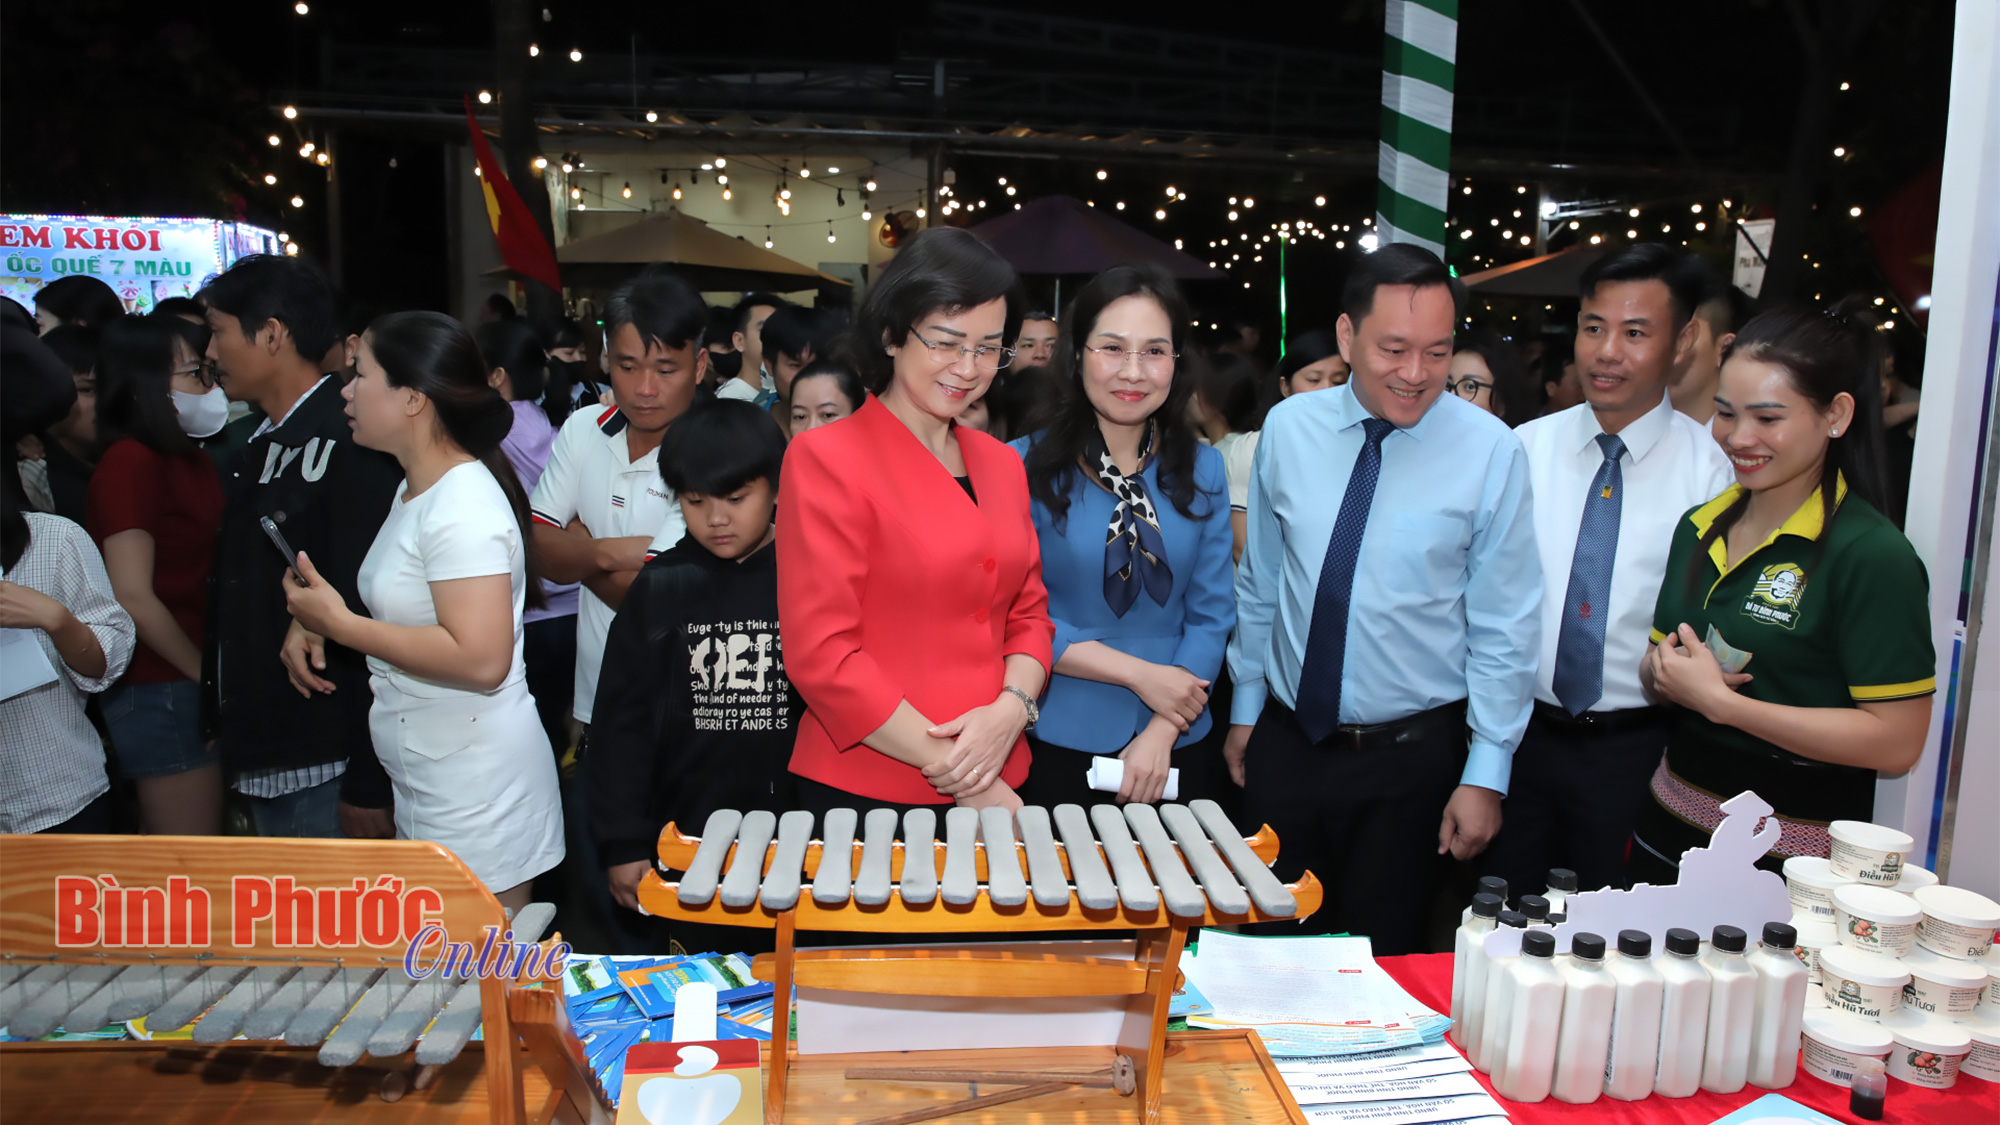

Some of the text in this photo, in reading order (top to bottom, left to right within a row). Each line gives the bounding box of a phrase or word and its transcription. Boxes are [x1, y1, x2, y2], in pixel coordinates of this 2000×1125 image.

[7, 251, 192, 276] ỐC QUẾ 7 MÀU
[734, 621, 744, 630] is
[693, 693, 708, 703] the
[726, 692, 738, 703] of
[725, 719, 738, 731] ET
[1859, 870, 1881, 880] Điều
[1858, 1006, 1881, 1017] Tươi
